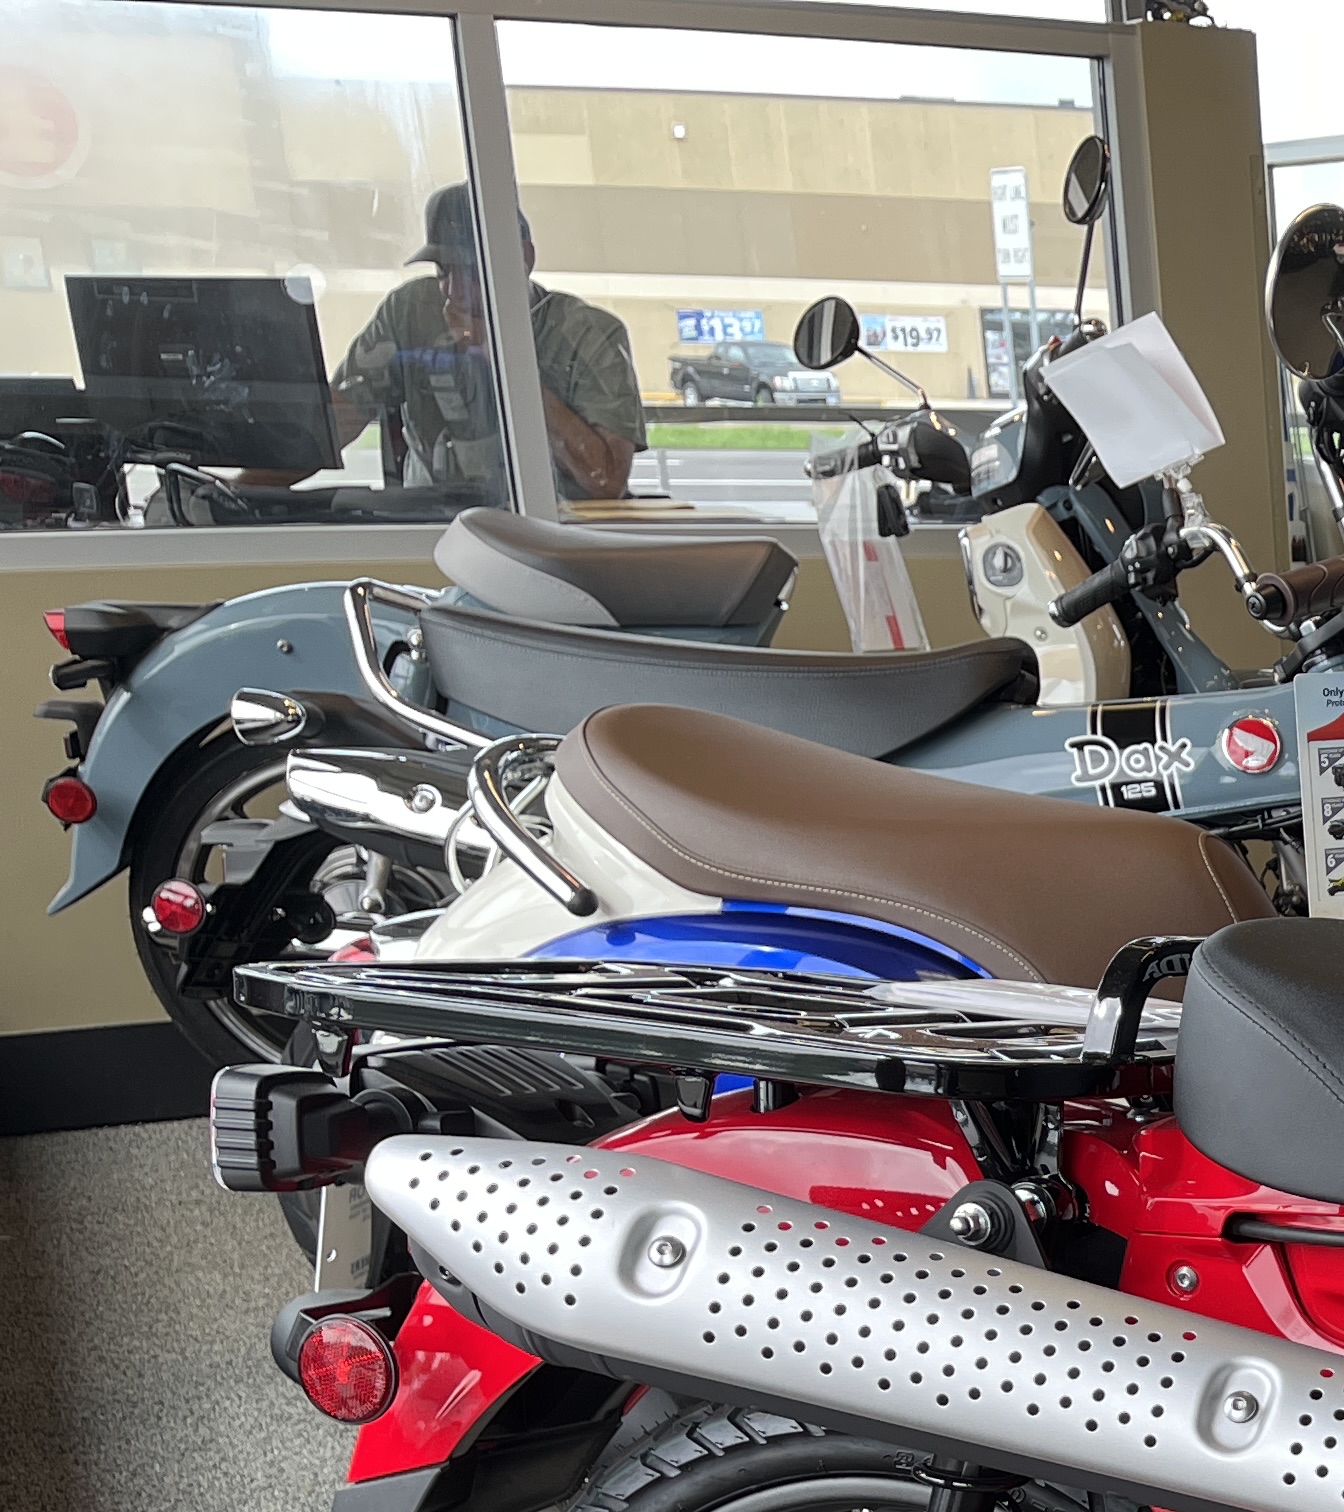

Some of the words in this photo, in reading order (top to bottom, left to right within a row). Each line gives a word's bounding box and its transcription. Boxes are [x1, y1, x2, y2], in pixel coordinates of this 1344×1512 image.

[1322, 687, 1344, 698] Only
[1064, 734, 1195, 787] Dax
[1320, 753, 1329, 767] 5
[1120, 781, 1158, 801] 125
[1323, 803, 1333, 817] 8
[1327, 853, 1336, 868] 6
